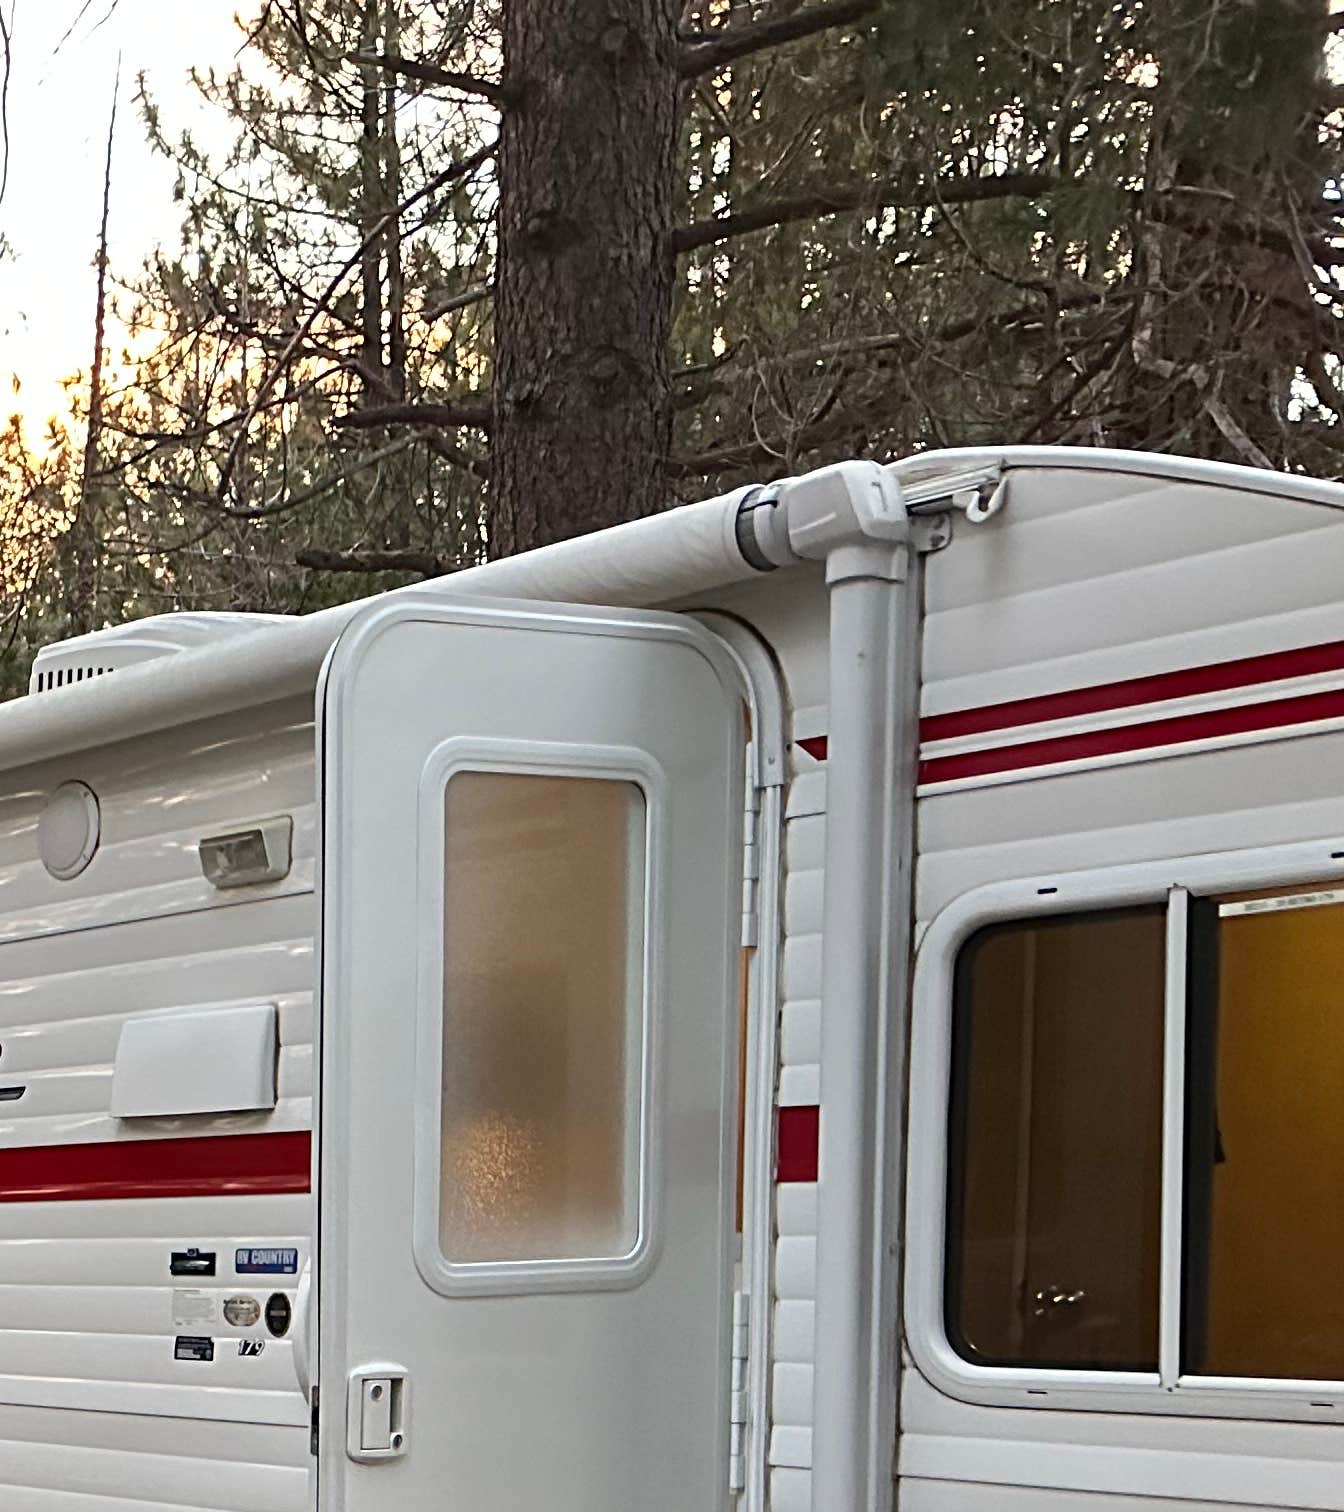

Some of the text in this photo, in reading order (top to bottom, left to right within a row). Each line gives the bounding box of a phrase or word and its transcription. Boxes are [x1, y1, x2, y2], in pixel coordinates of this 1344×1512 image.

[237, 1250, 296, 1265] RV COUNTRY
[238, 1339, 265, 1356] 179
